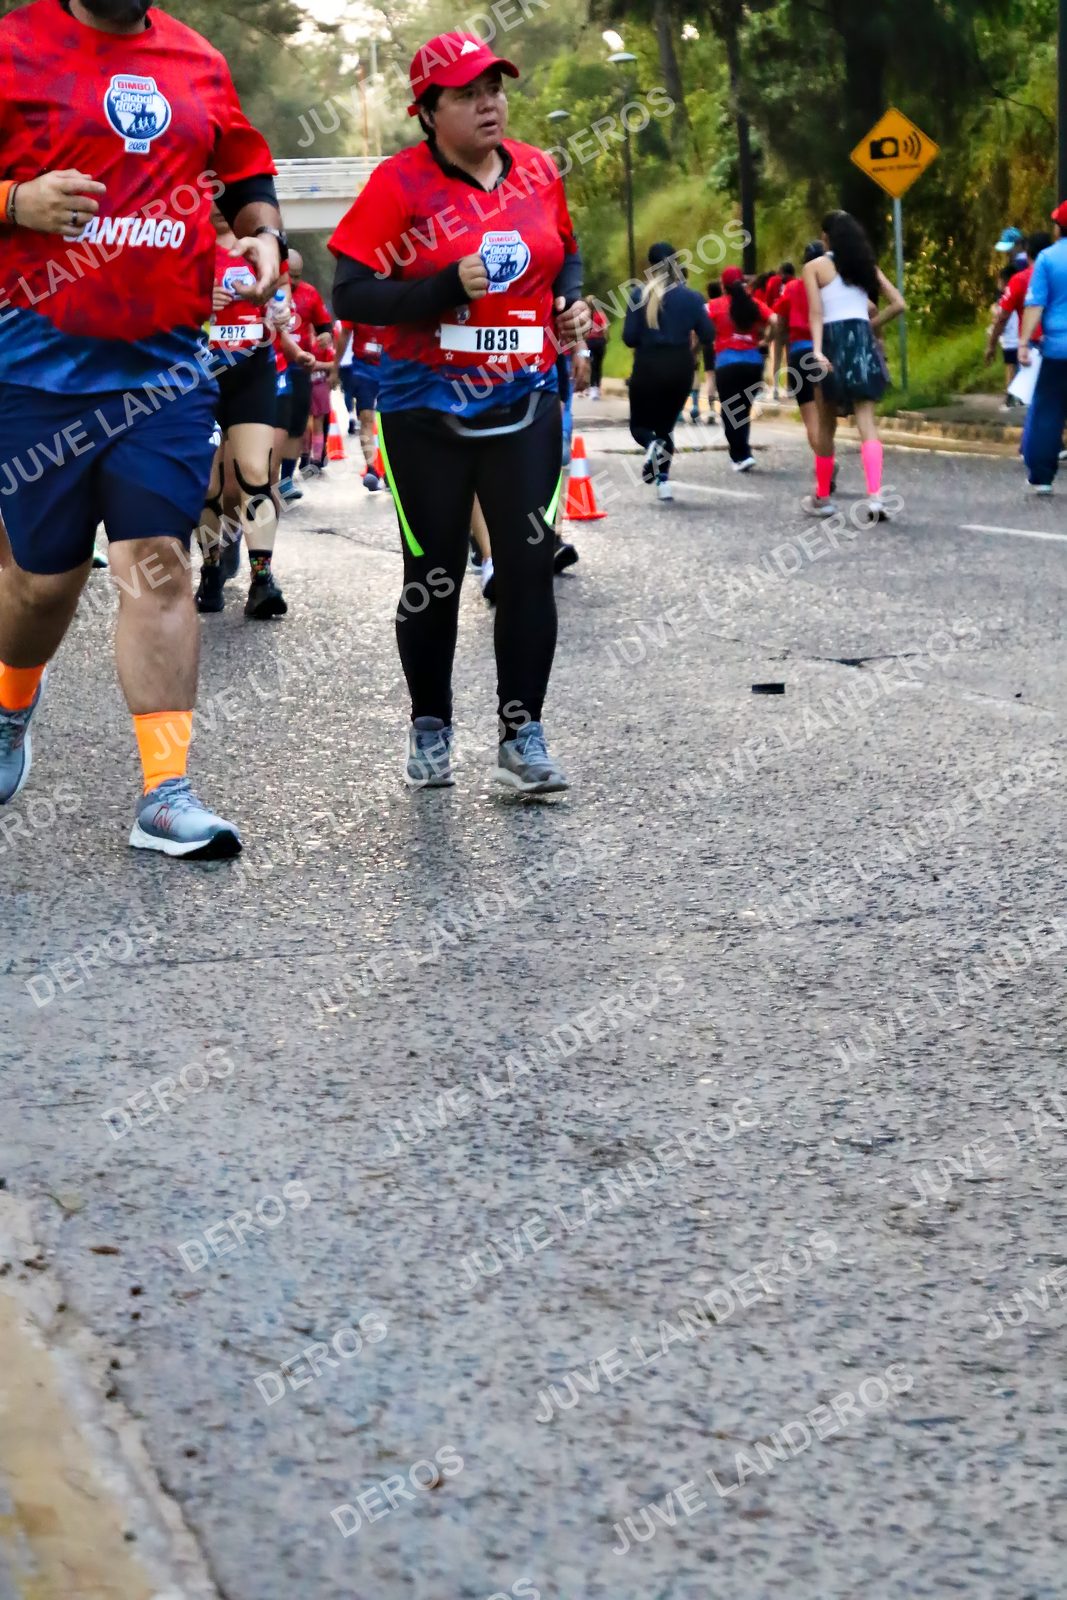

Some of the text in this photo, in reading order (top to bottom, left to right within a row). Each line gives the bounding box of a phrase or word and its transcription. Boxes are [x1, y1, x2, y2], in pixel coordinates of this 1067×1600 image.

[120, 93, 153, 104] Global
[115, 101, 142, 112] Race
[63, 216, 186, 249] ANTIAGO
[220, 326, 246, 339] 2972
[475, 328, 519, 351] 1839
